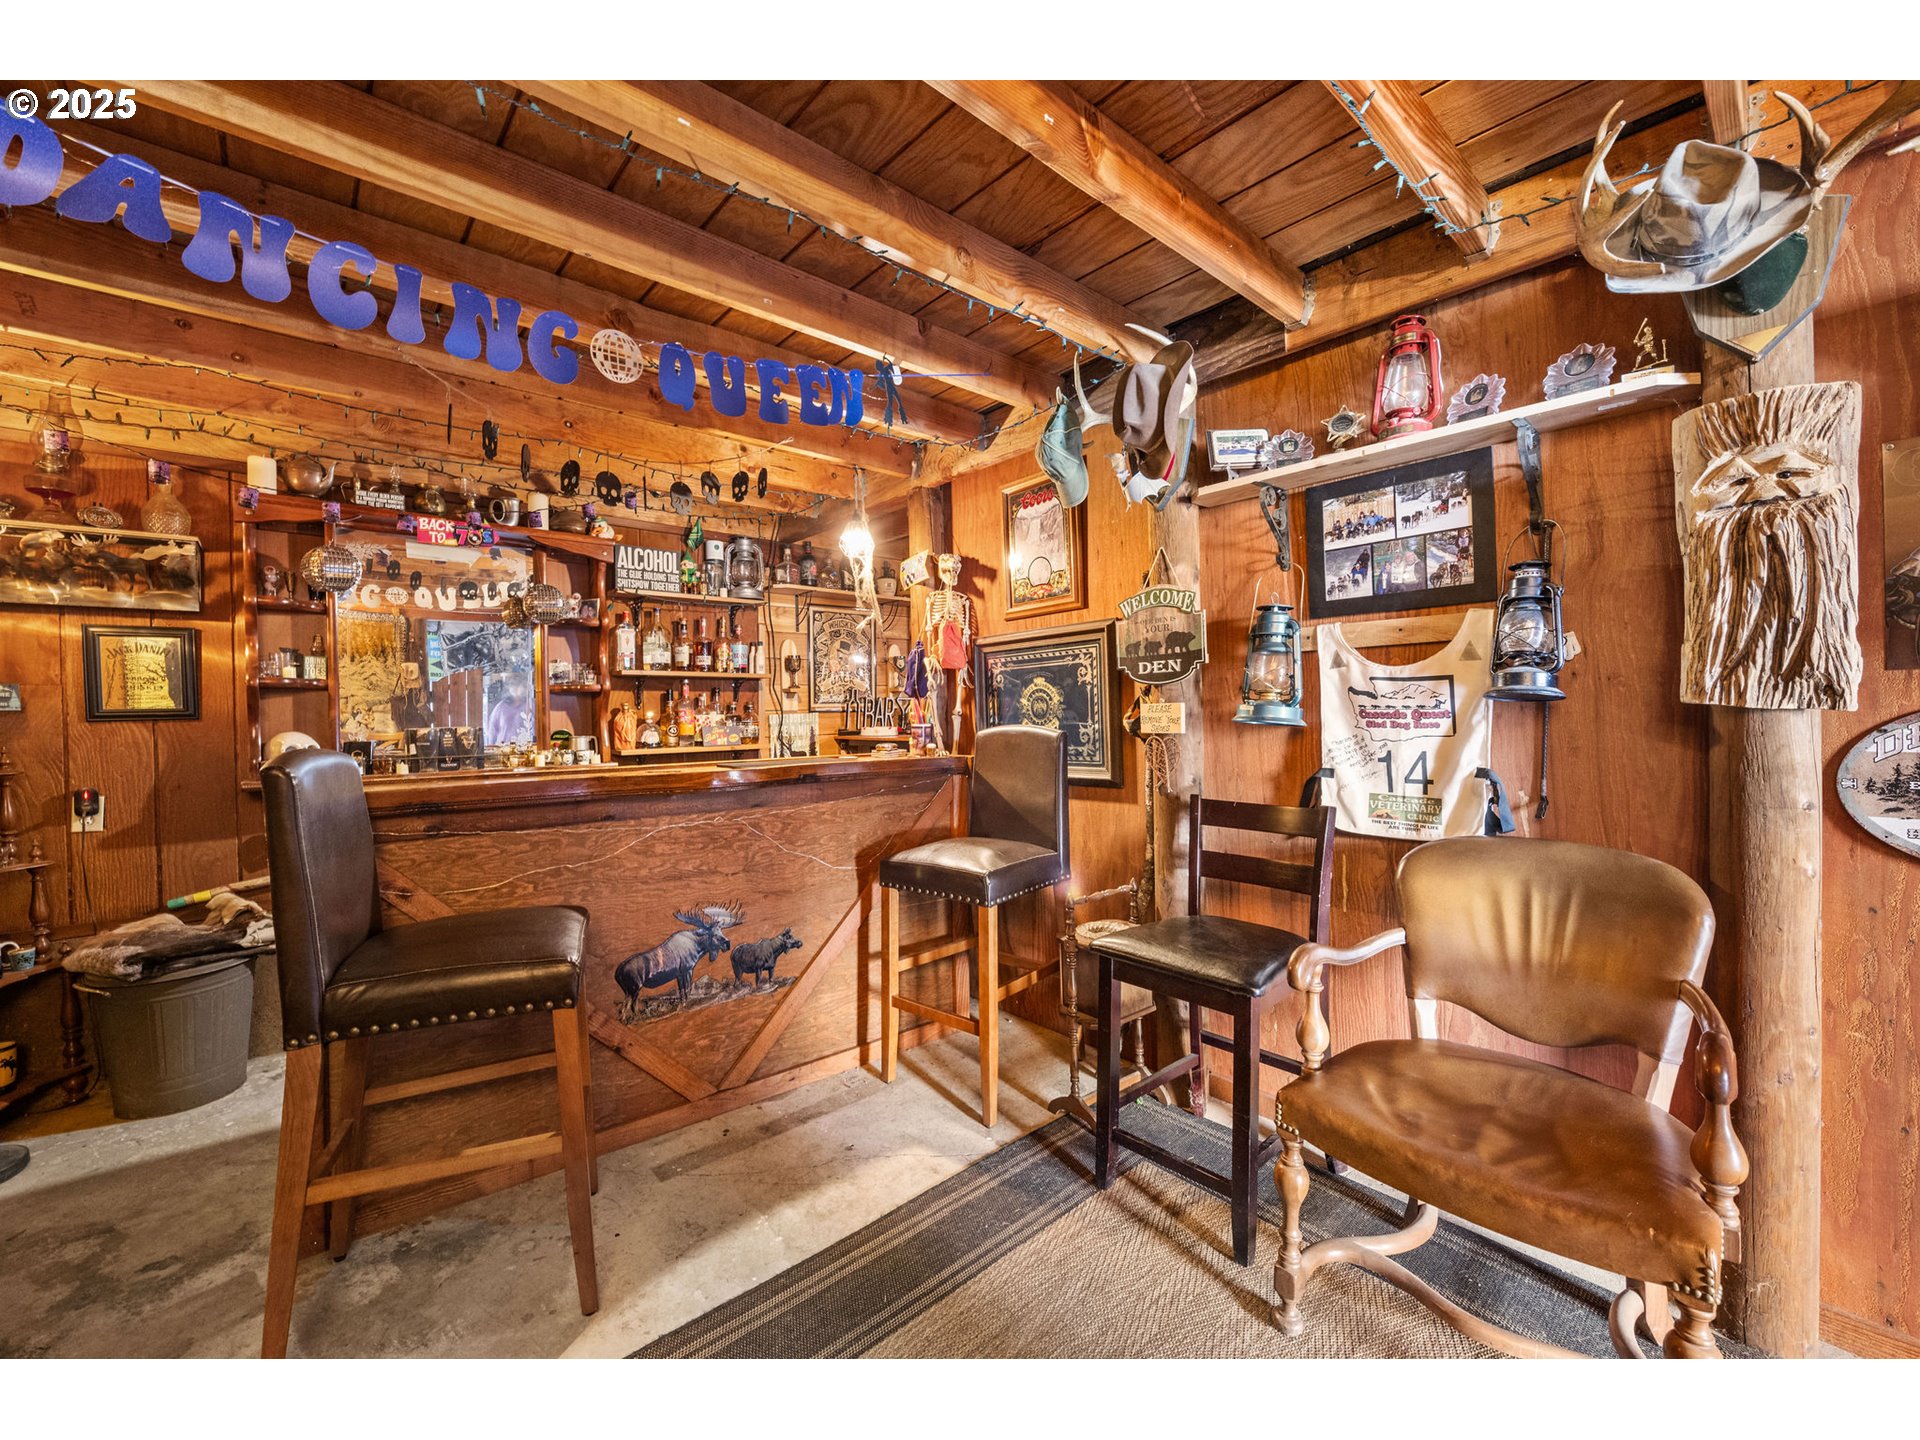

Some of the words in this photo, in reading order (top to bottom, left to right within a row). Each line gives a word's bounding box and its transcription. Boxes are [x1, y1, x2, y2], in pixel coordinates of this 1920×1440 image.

[0, 97, 578, 384] DANCING
[659, 342, 864, 426] QUEEN
[1021, 488, 1054, 509] Coors
[419, 517, 455, 532] BACK
[429, 531, 446, 543] TO
[617, 545, 680, 574] ALCOHOL
[617, 569, 628, 578] THE
[643, 571, 666, 582] HOLDING
[667, 573, 680, 583] THIS
[617, 578, 650, 590] SHITSHOW
[650, 581, 680, 592] TOGETHER
[1120, 589, 1195, 619] WELCOME
[1145, 623, 1170, 633] YOUR
[1138, 658, 1182, 675] DEN
[830, 674, 857, 687] JACK
[864, 696, 895, 728] BAR
[1147, 704, 1173, 713] PLEASE
[1359, 708, 1407, 719] Cascade
[1411, 708, 1452, 721] Quest
[1366, 720, 1387, 729] Sled
[1390, 720, 1411, 731] Dog
[1413, 720, 1441, 729] Race
[1377, 750, 1434, 796] 14
[1378, 794, 1436, 805] Cascade
[1370, 800, 1442, 815] VETERINARY
[1407, 812, 1440, 823] CLINIC
